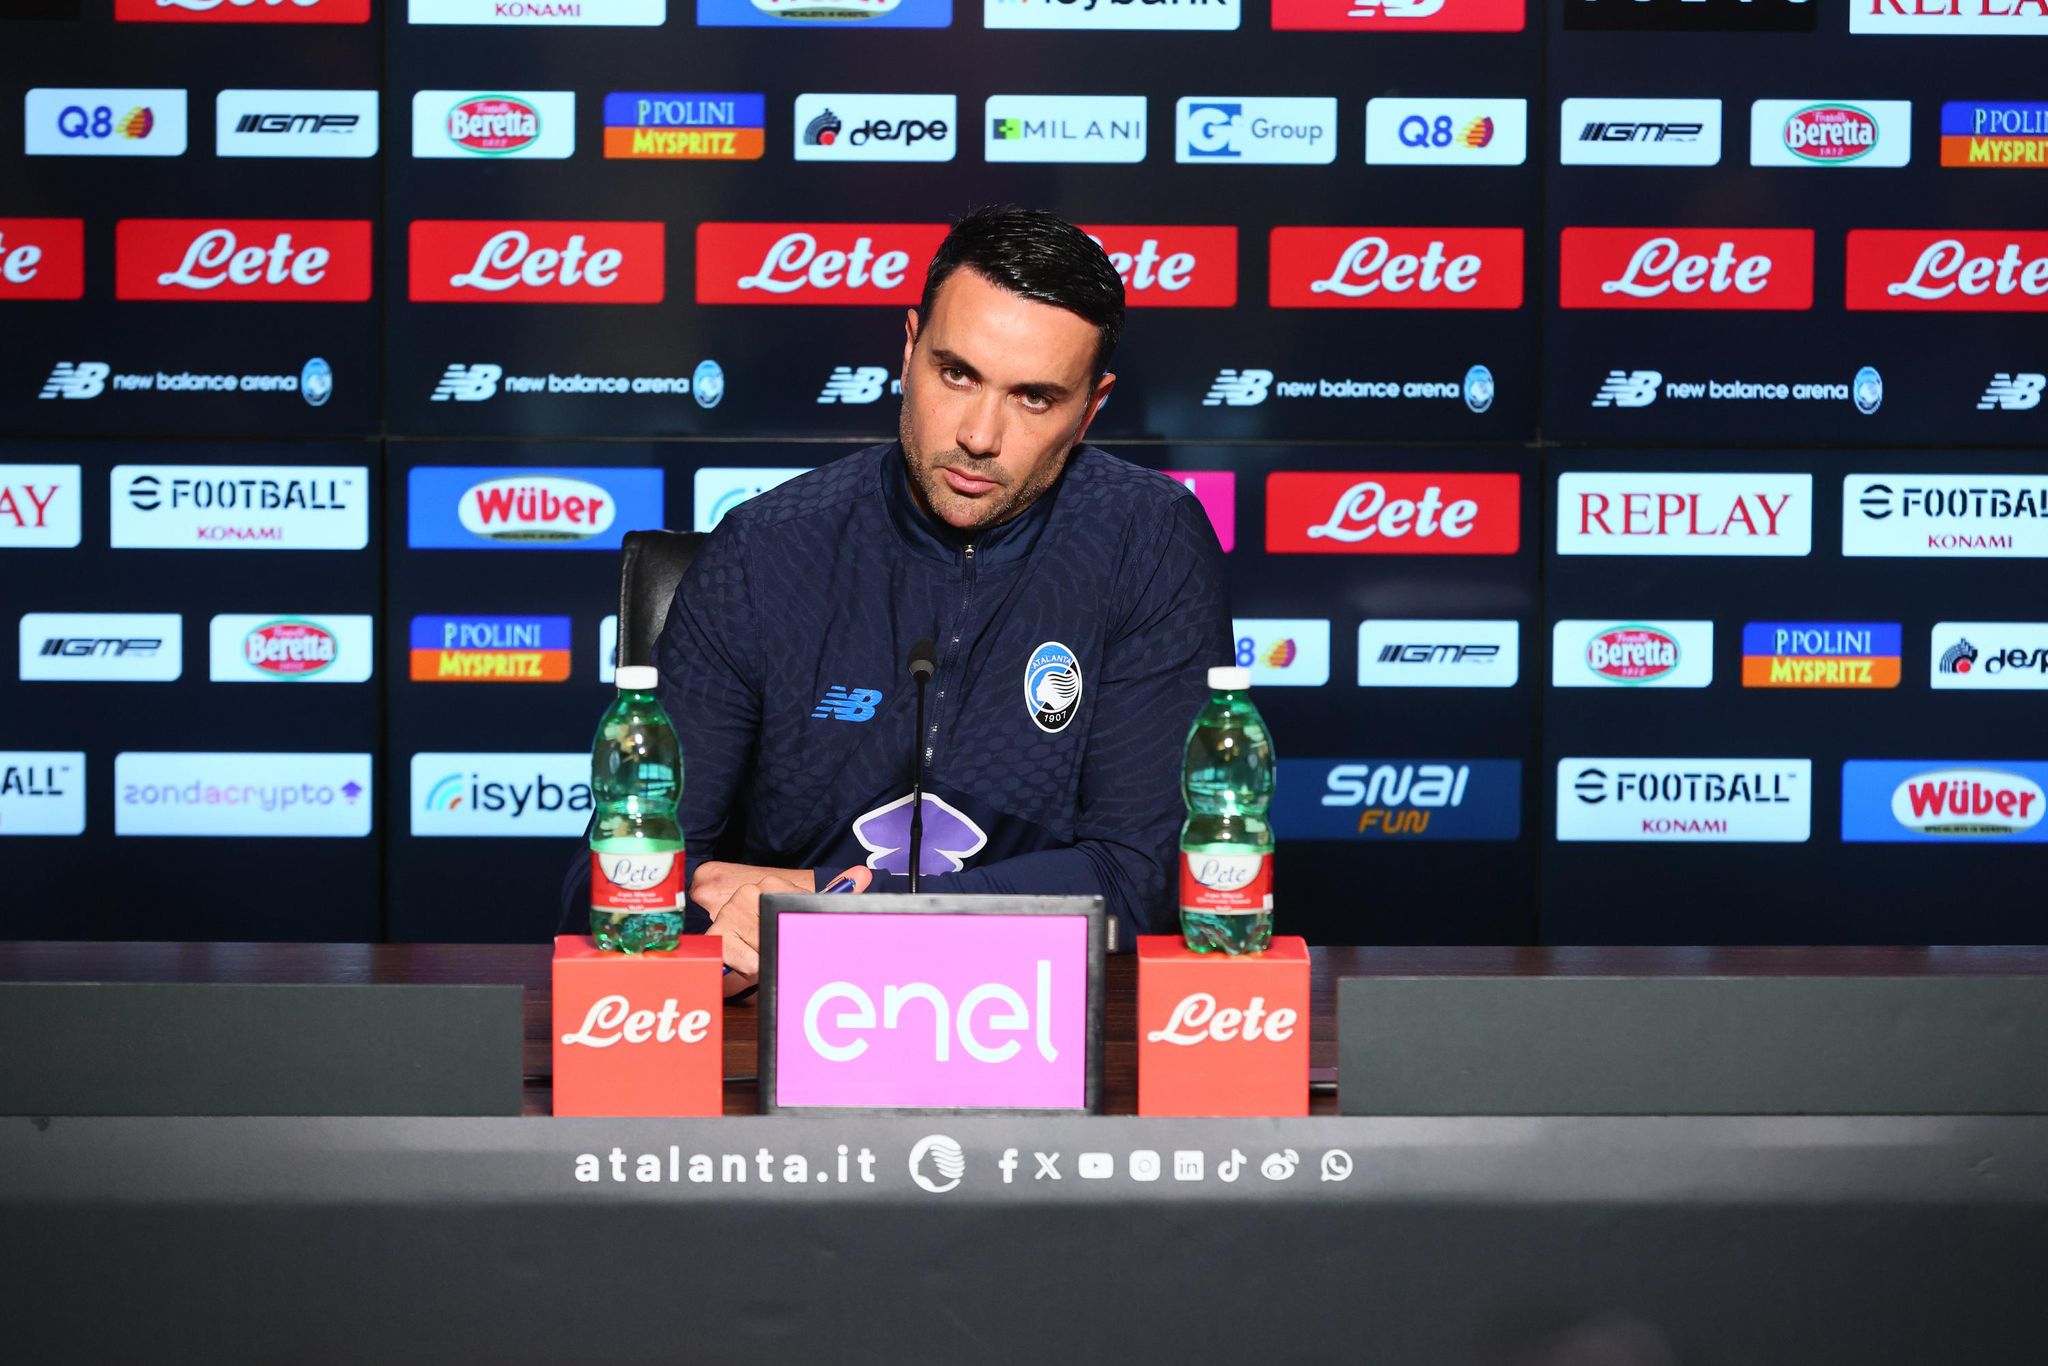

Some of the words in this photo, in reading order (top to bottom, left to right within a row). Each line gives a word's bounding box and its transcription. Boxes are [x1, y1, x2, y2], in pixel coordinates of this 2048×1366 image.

[496, 4, 582, 18] KONAMI
[58, 106, 114, 140] Q8
[449, 108, 537, 141] Beretta
[850, 120, 950, 148] despe
[1024, 121, 1141, 140] MILANI
[1252, 118, 1325, 147] Group
[1399, 115, 1454, 150] Q8
[1788, 117, 1873, 148] Beretta
[632, 128, 737, 155] MYSPRITZ
[1970, 136, 2048, 164] MYSPRI
[158, 229, 331, 291] Lete
[450, 231, 624, 293] Lete
[738, 233, 911, 295] Lete
[1086, 234, 1197, 291] ete
[1311, 237, 1483, 299] Lete
[1602, 238, 1774, 299] Lete
[113, 375, 155, 392] new
[156, 372, 239, 392] balance
[240, 376, 300, 393] arena
[505, 377, 548, 394] new
[548, 374, 631, 395] balance
[632, 378, 691, 395] arena
[1277, 382, 1318, 399] new
[1320, 379, 1402, 399] balance
[1403, 383, 1461, 400] arena
[1666, 383, 1707, 400] new
[1710, 381, 1791, 401] balance
[1791, 384, 1850, 401] arena
[475, 487, 604, 526] Wüber
[1307, 482, 1480, 544] Lete
[1581, 494, 1791, 537] REPLAY
[198, 528, 283, 541] KONAMI
[1929, 536, 2014, 550] KONAMI
[248, 634, 335, 664] Beretta
[1236, 636, 1256, 668] 8
[1591, 638, 1676, 670] Beretta
[1770, 657, 1873, 684] MYSPRITZ
[1044, 710, 1067, 723] 1907
[473, 775, 593, 819] isyba
[1908, 780, 2036, 818] Wüber
[1358, 809, 1431, 836] FUN
[1643, 820, 1728, 834] KONAMI
[561, 995, 712, 1050] Lete
[803, 960, 1060, 1066] enel
[1148, 993, 1299, 1047] Lete
[575, 1144, 877, 1184] atalanta.it
